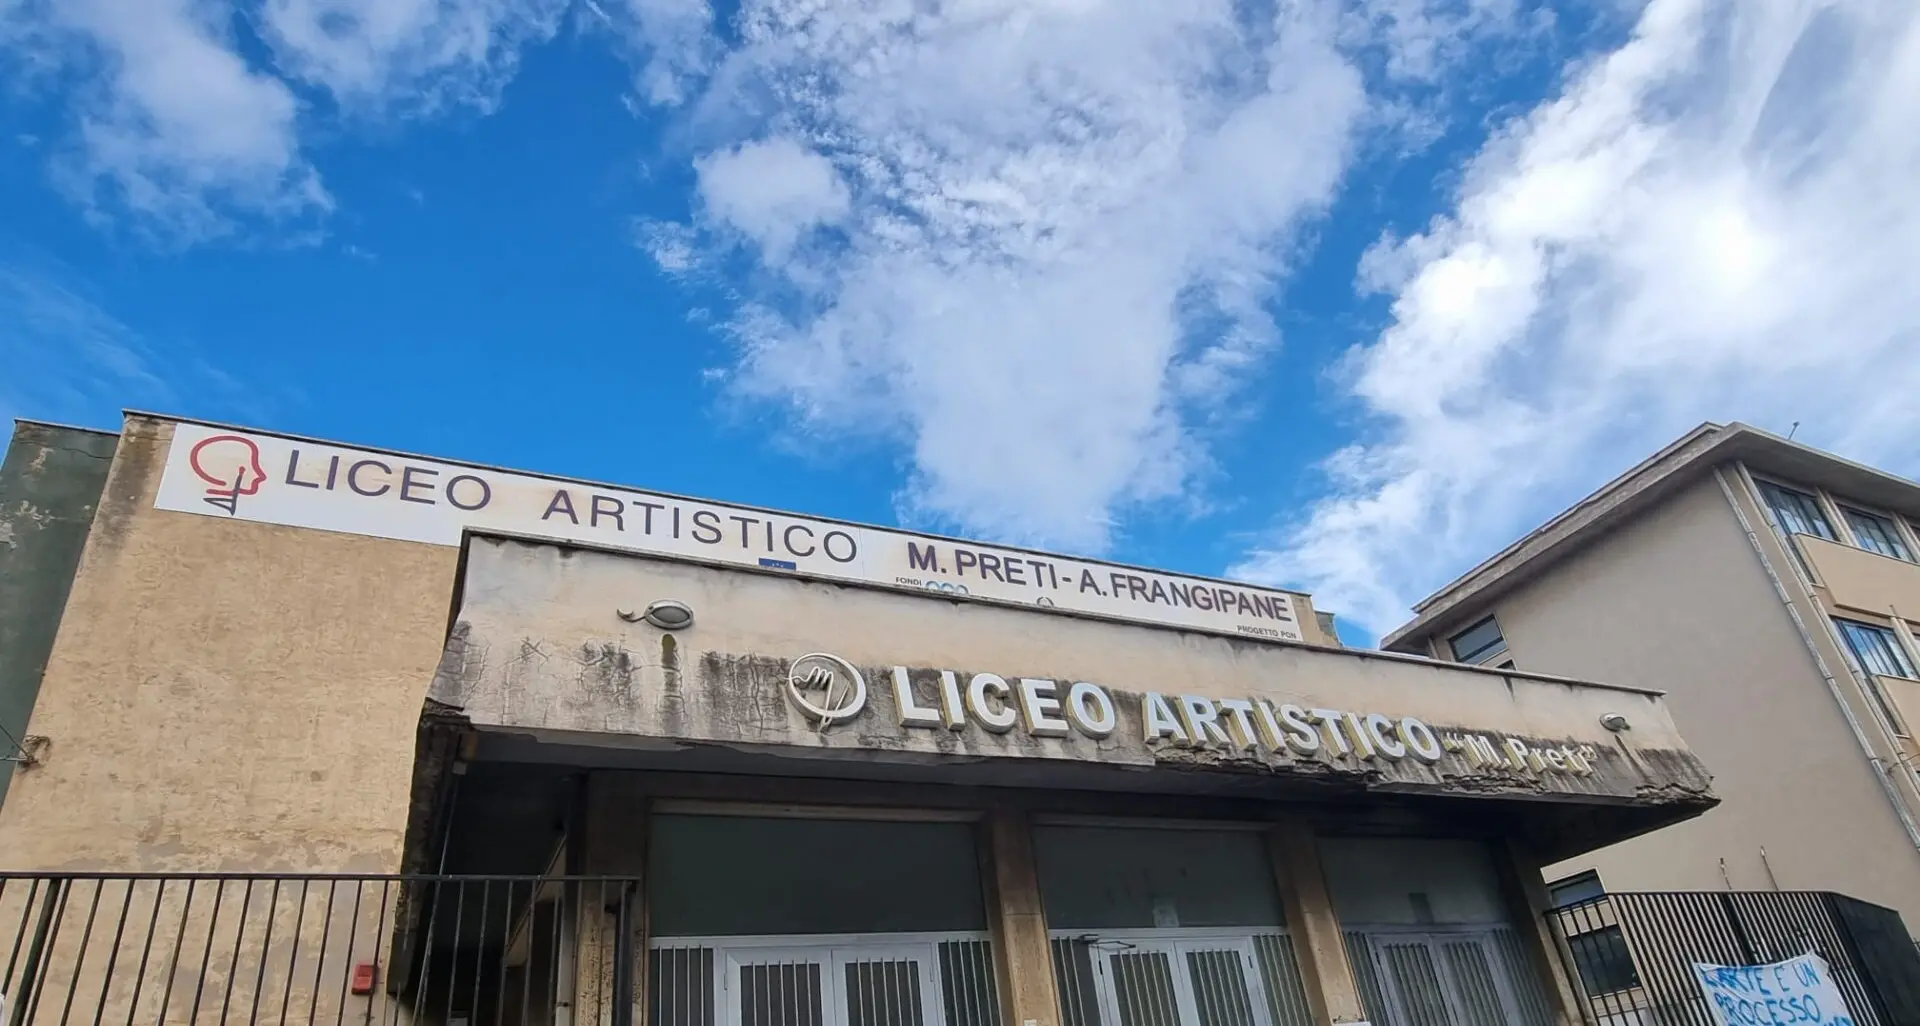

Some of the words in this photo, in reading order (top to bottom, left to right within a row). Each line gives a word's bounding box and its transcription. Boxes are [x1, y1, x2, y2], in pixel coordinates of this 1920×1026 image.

[284, 449, 492, 511] LICEO
[541, 489, 858, 563] ARTISTICO
[895, 576, 922, 587] FONDI
[1236, 625, 1278, 637] PROGETTO
[889, 665, 1118, 741] LICEO
[1140, 691, 1442, 764] ARTISTICO
[1713, 993, 1821, 1026] PROCESSO
